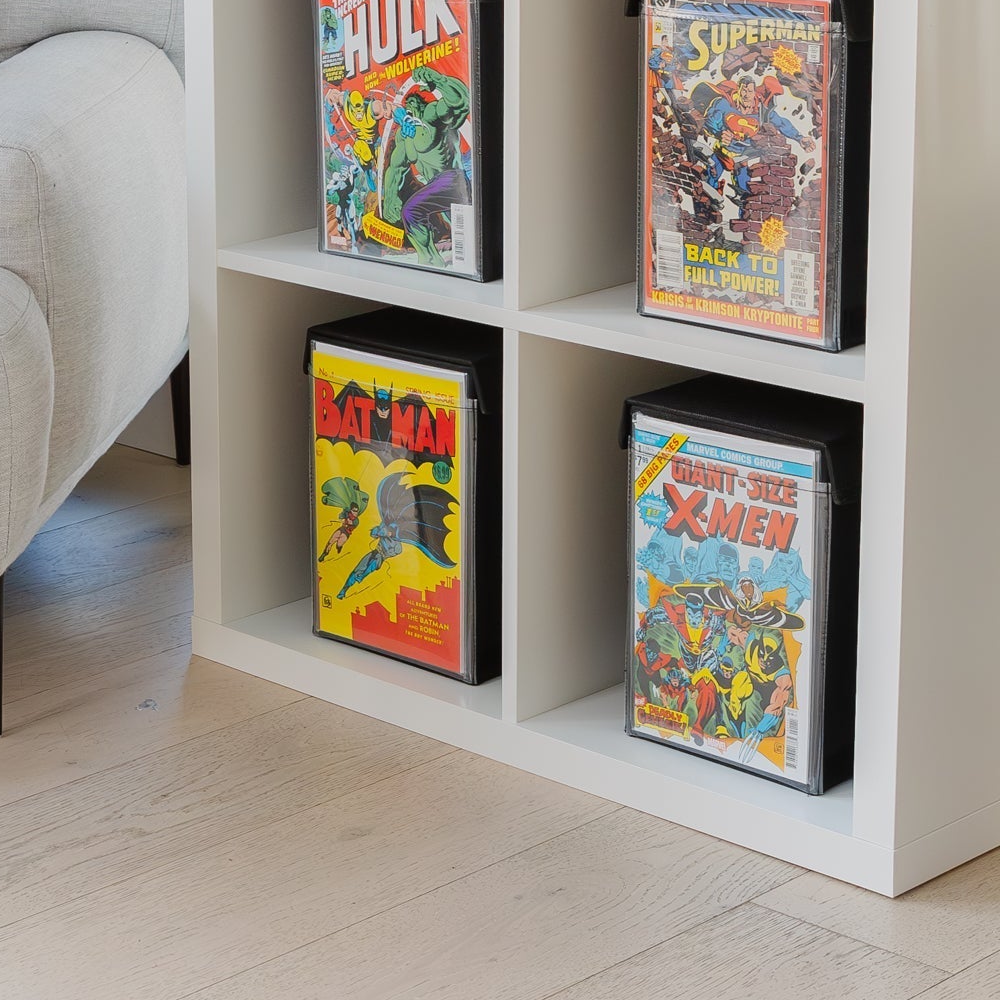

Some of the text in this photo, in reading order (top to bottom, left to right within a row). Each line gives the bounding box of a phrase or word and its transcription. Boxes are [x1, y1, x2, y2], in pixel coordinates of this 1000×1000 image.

[688, 19, 821, 71] SUPERMAN
[364, 71, 377, 83] AND
[684, 243, 778, 275] BACK TO
[684, 265, 780, 297] FULL POWER!
[652, 290, 684, 308] KRISIS
[695, 298, 740, 319] KRIMSON
[744, 308, 803, 330] KRYPTONITE
[637, 476, 648, 489] 68
[646, 462, 659, 479] BIG
[656, 438, 680, 465] PAGES
[687, 443, 718, 458] MARVEL
[721, 449, 752, 465] COMICS
[671, 455, 798, 508] GIANT-SIZE
[663, 482, 799, 554] X-MEN
[407, 613, 418, 622] THE
[420, 616, 449, 630] BATMAN
